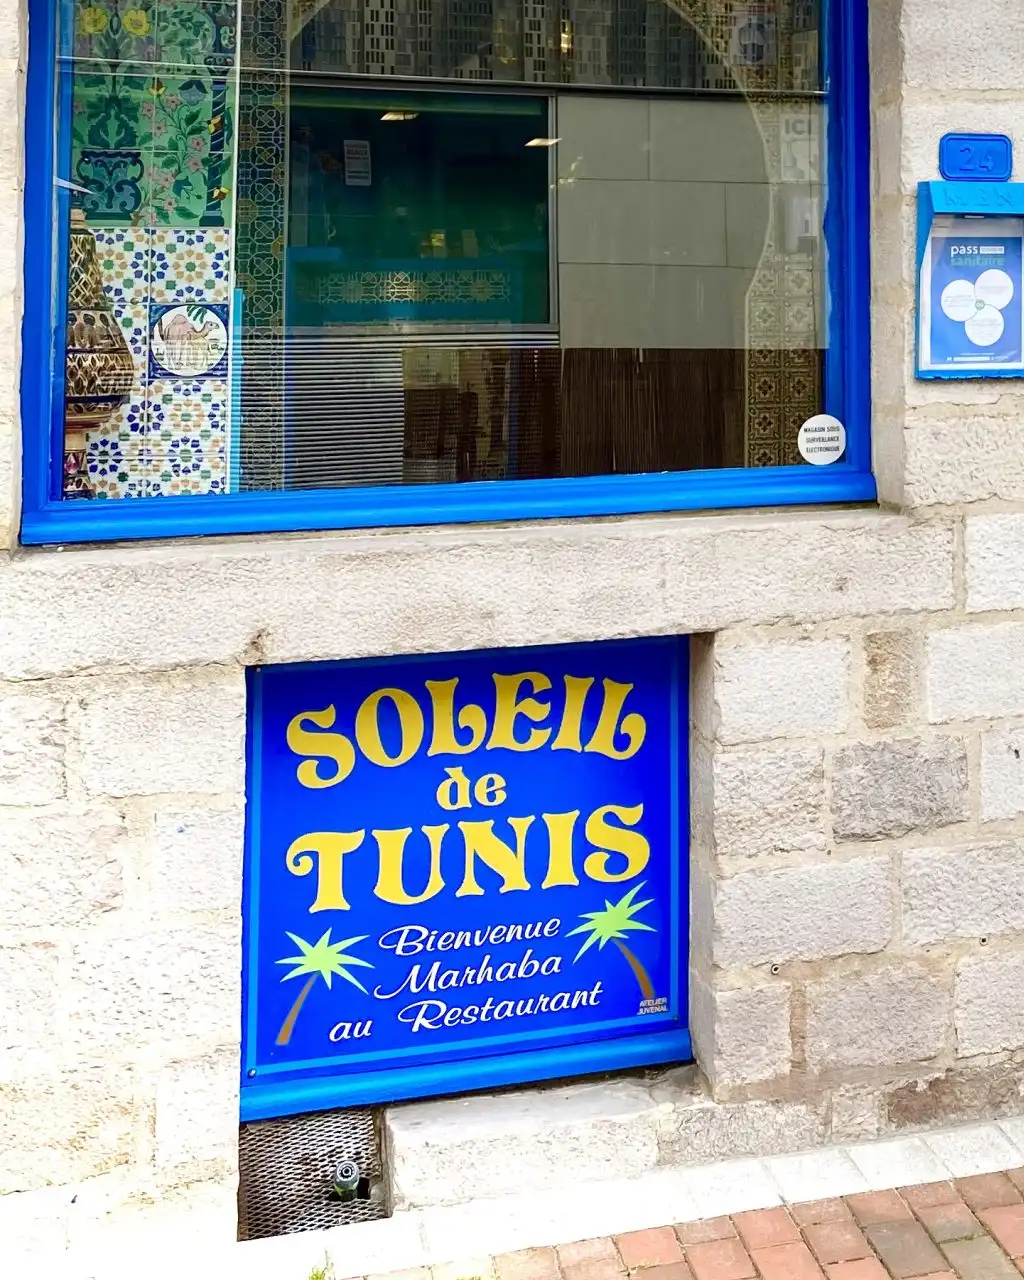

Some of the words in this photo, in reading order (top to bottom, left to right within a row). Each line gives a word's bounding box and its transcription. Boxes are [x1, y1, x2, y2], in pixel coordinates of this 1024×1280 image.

[959, 143, 994, 172] 24
[950, 245, 979, 258] pass
[286, 671, 647, 789] SOLEIL
[436, 766, 507, 811] de
[286, 803, 650, 914] TUNIS
[378, 916, 561, 956] Bienvenue
[373, 949, 561, 999] Marhaba
[329, 1019, 373, 1042] au
[397, 980, 603, 1032] Restaurant
